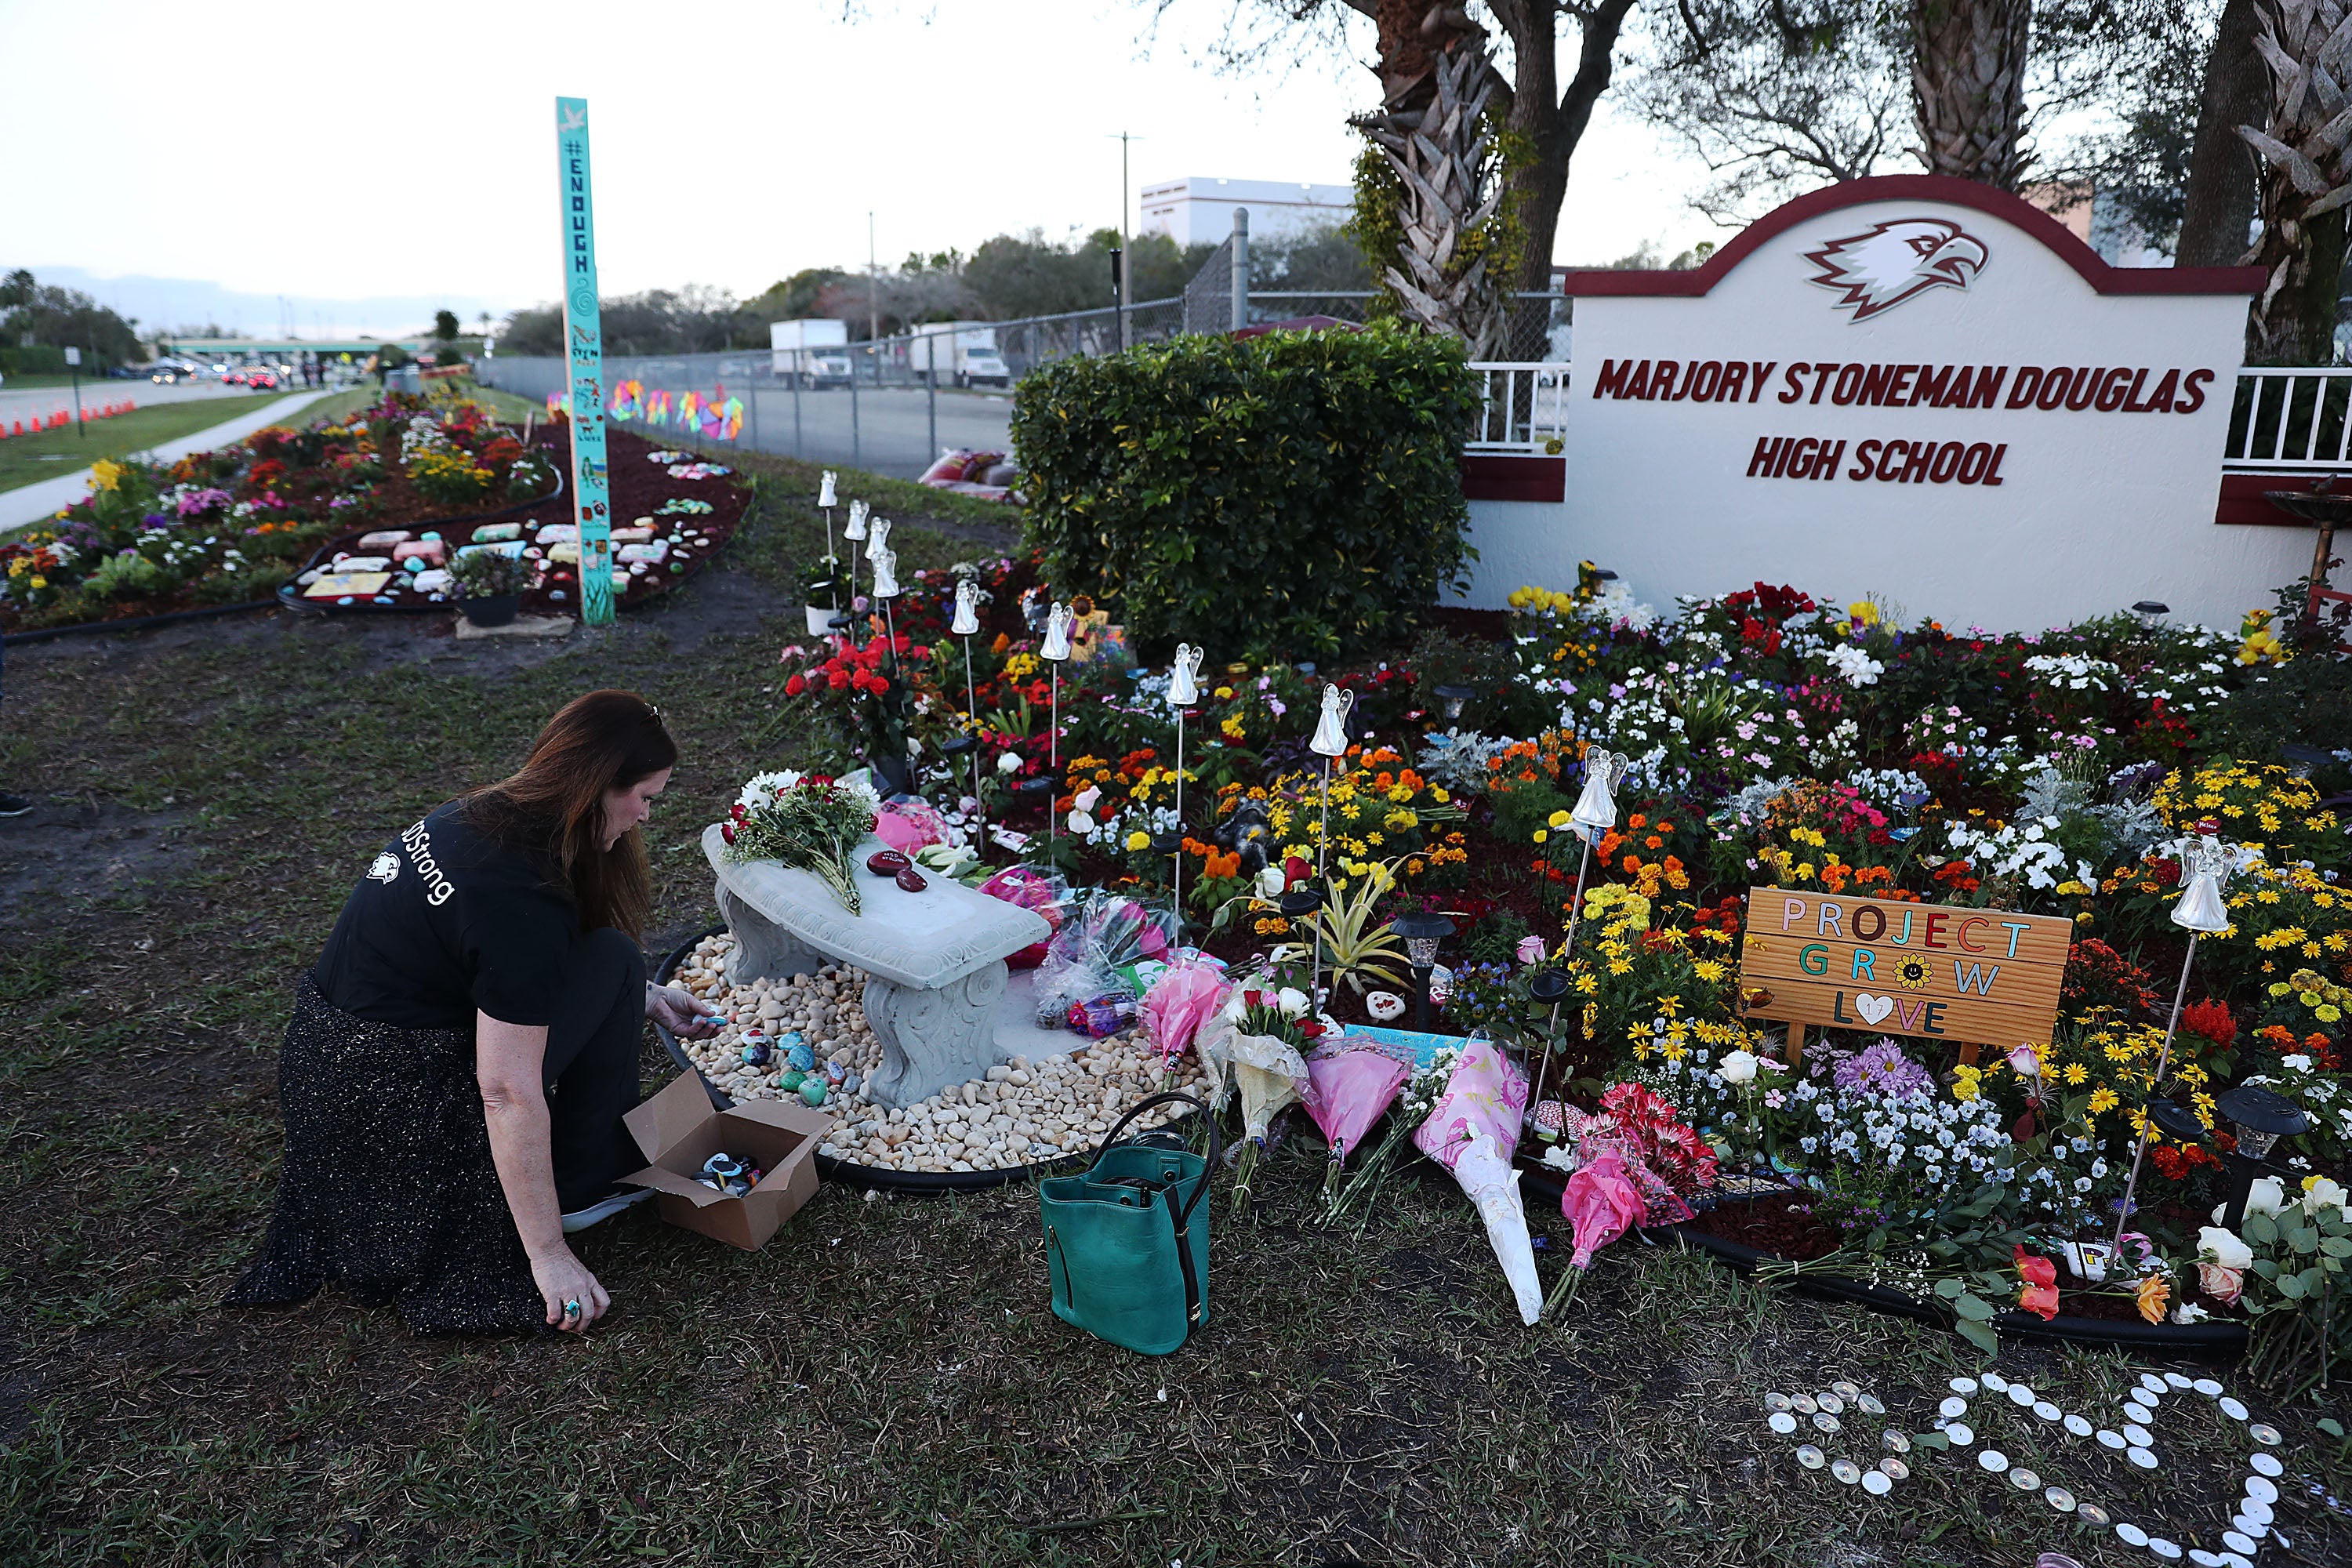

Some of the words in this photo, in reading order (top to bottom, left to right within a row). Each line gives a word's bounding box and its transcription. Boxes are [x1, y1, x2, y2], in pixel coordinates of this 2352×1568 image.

[1592, 358, 1778, 403] MARJORY
[1777, 361, 2005, 409] STONEMAN
[2004, 366, 2216, 415] DOUGLAS
[1745, 436, 1846, 481] HIGH
[1849, 439, 2009, 486] SCHOOL
[1781, 897, 2031, 959] PROJECT
[1864, 1003, 1885, 1017] 17
